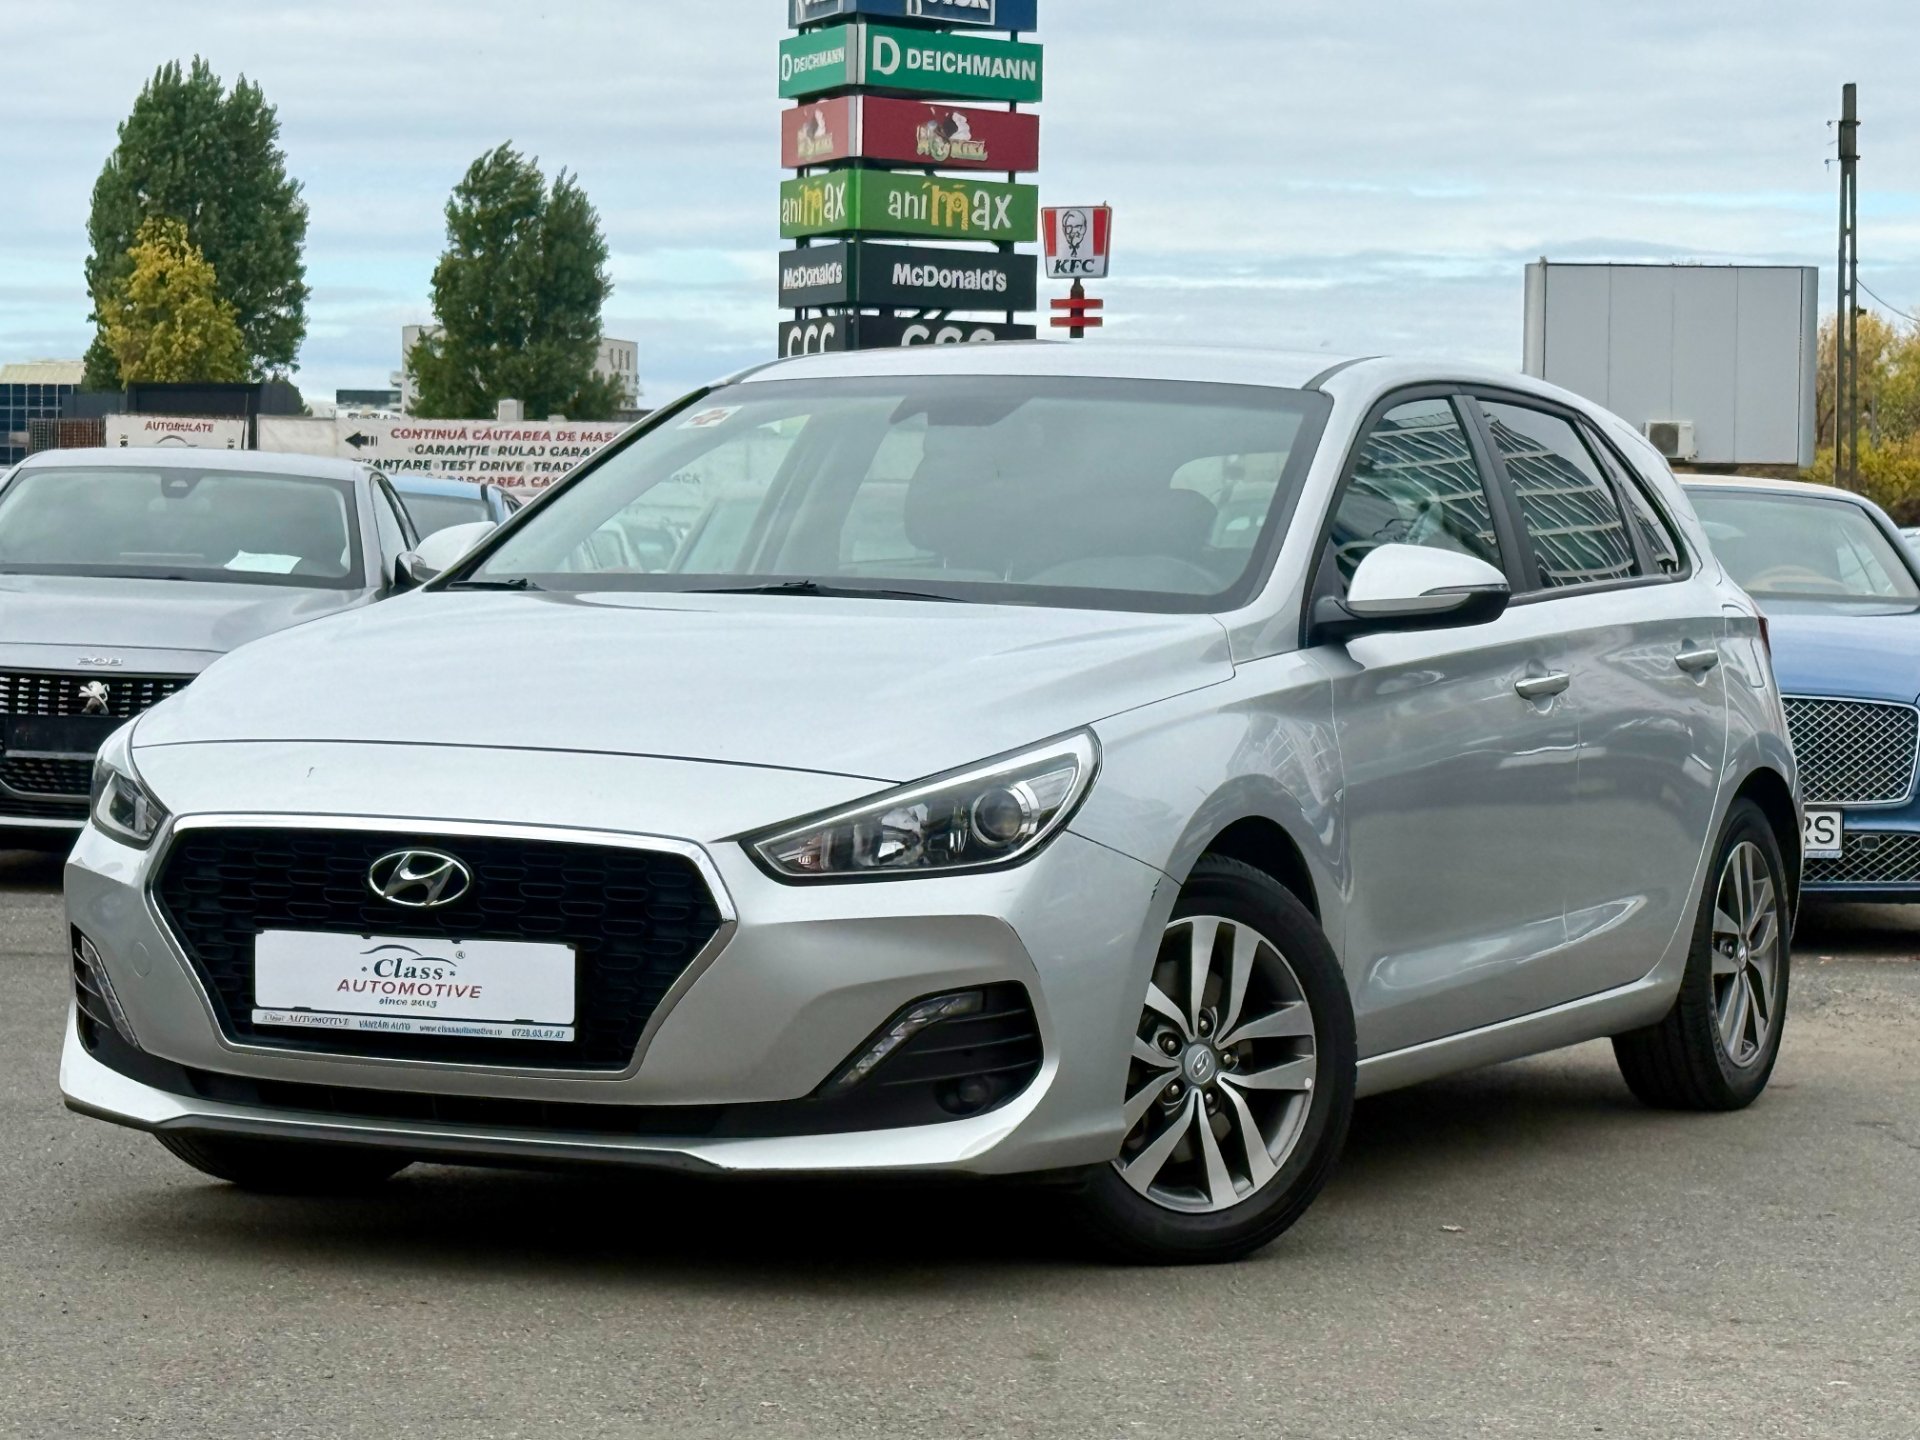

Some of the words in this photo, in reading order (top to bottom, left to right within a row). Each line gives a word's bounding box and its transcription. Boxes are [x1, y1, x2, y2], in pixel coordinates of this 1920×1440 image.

[794, 47, 844, 73] DEICHMANN
[907, 48, 1036, 81] DEICHMANN
[782, 182, 846, 226] animax
[888, 184, 1012, 231] animax
[783, 262, 842, 290] McDonald's
[892, 263, 1007, 292] McDonald's
[1053, 259, 1095, 274] KFC
[556, 430, 577, 442] DE
[497, 446, 545, 457] RULAJ
[441, 460, 476, 472] TEST
[479, 460, 524, 472] DRIVE
[533, 461, 577, 473] TRAD
[374, 957, 444, 980] Class
[337, 978, 483, 999] AUTOMOTIVE
[379, 996, 407, 1006] since
[391, 1020, 411, 1031] AUTO
